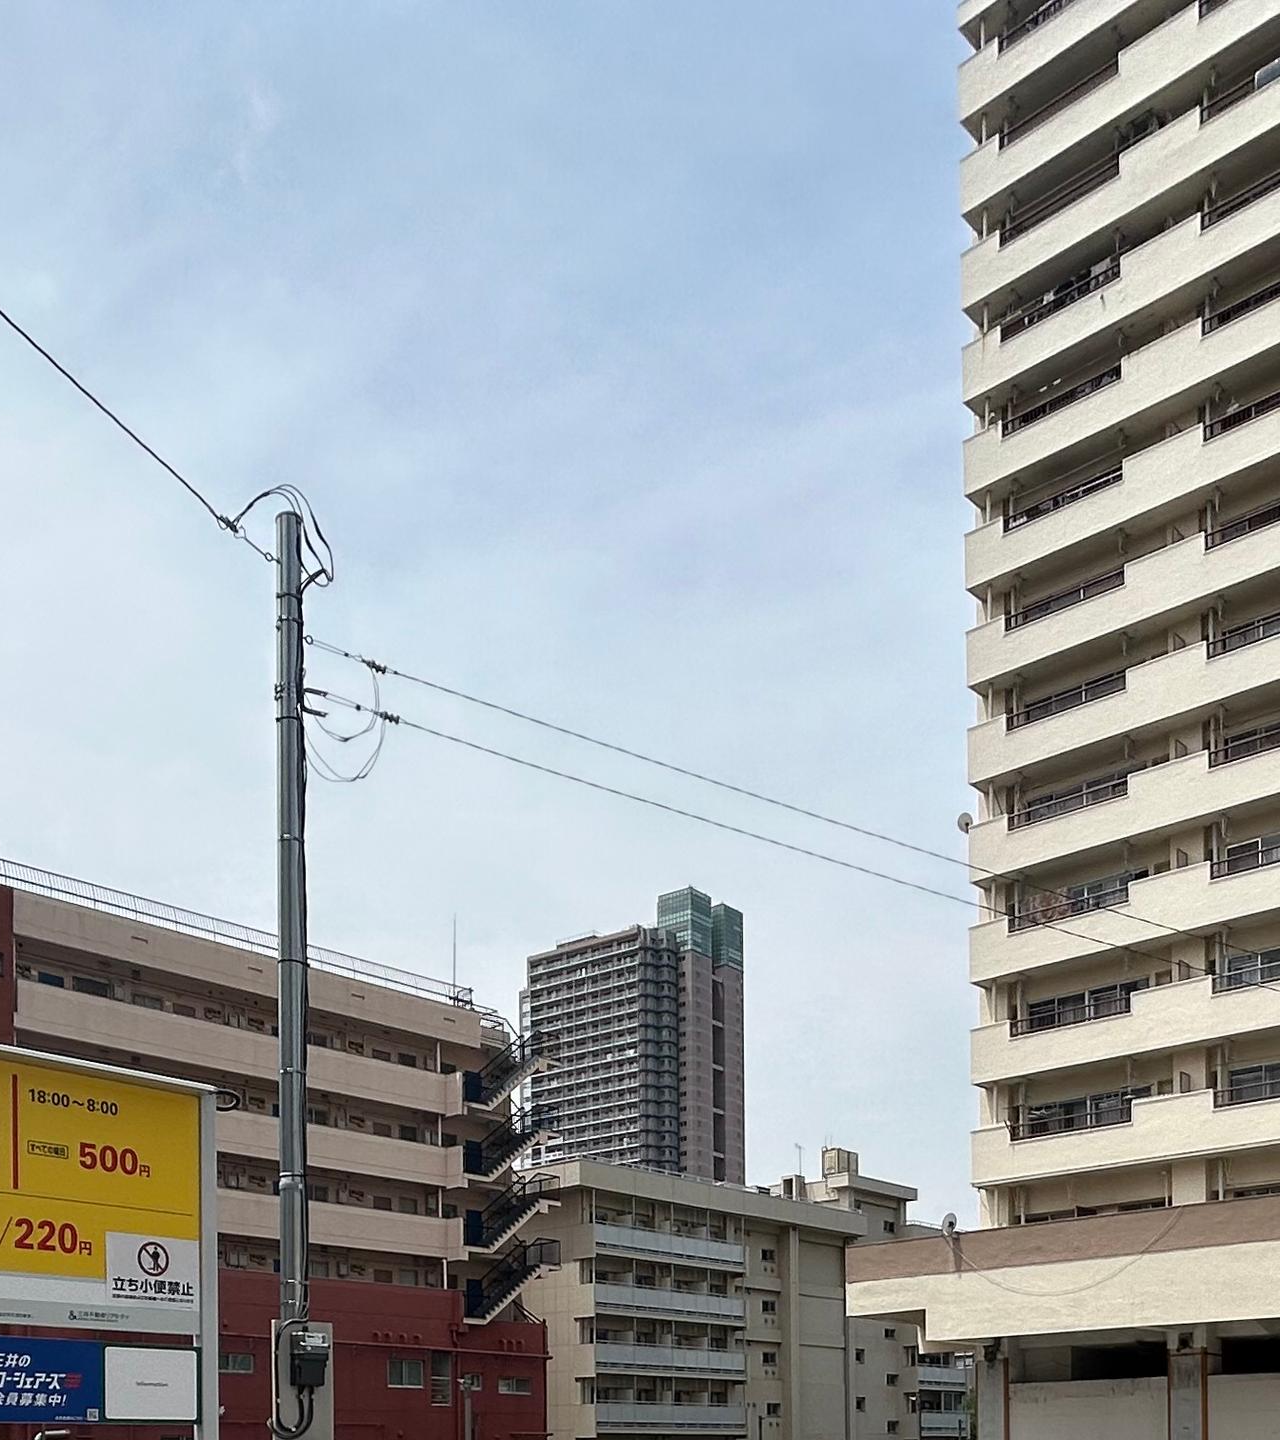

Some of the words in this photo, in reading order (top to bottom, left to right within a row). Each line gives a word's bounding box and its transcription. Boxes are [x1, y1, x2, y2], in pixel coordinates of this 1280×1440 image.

[79, 1142, 151, 1178] 500円
[112, 1276, 194, 1296] 立ち小便禁止
